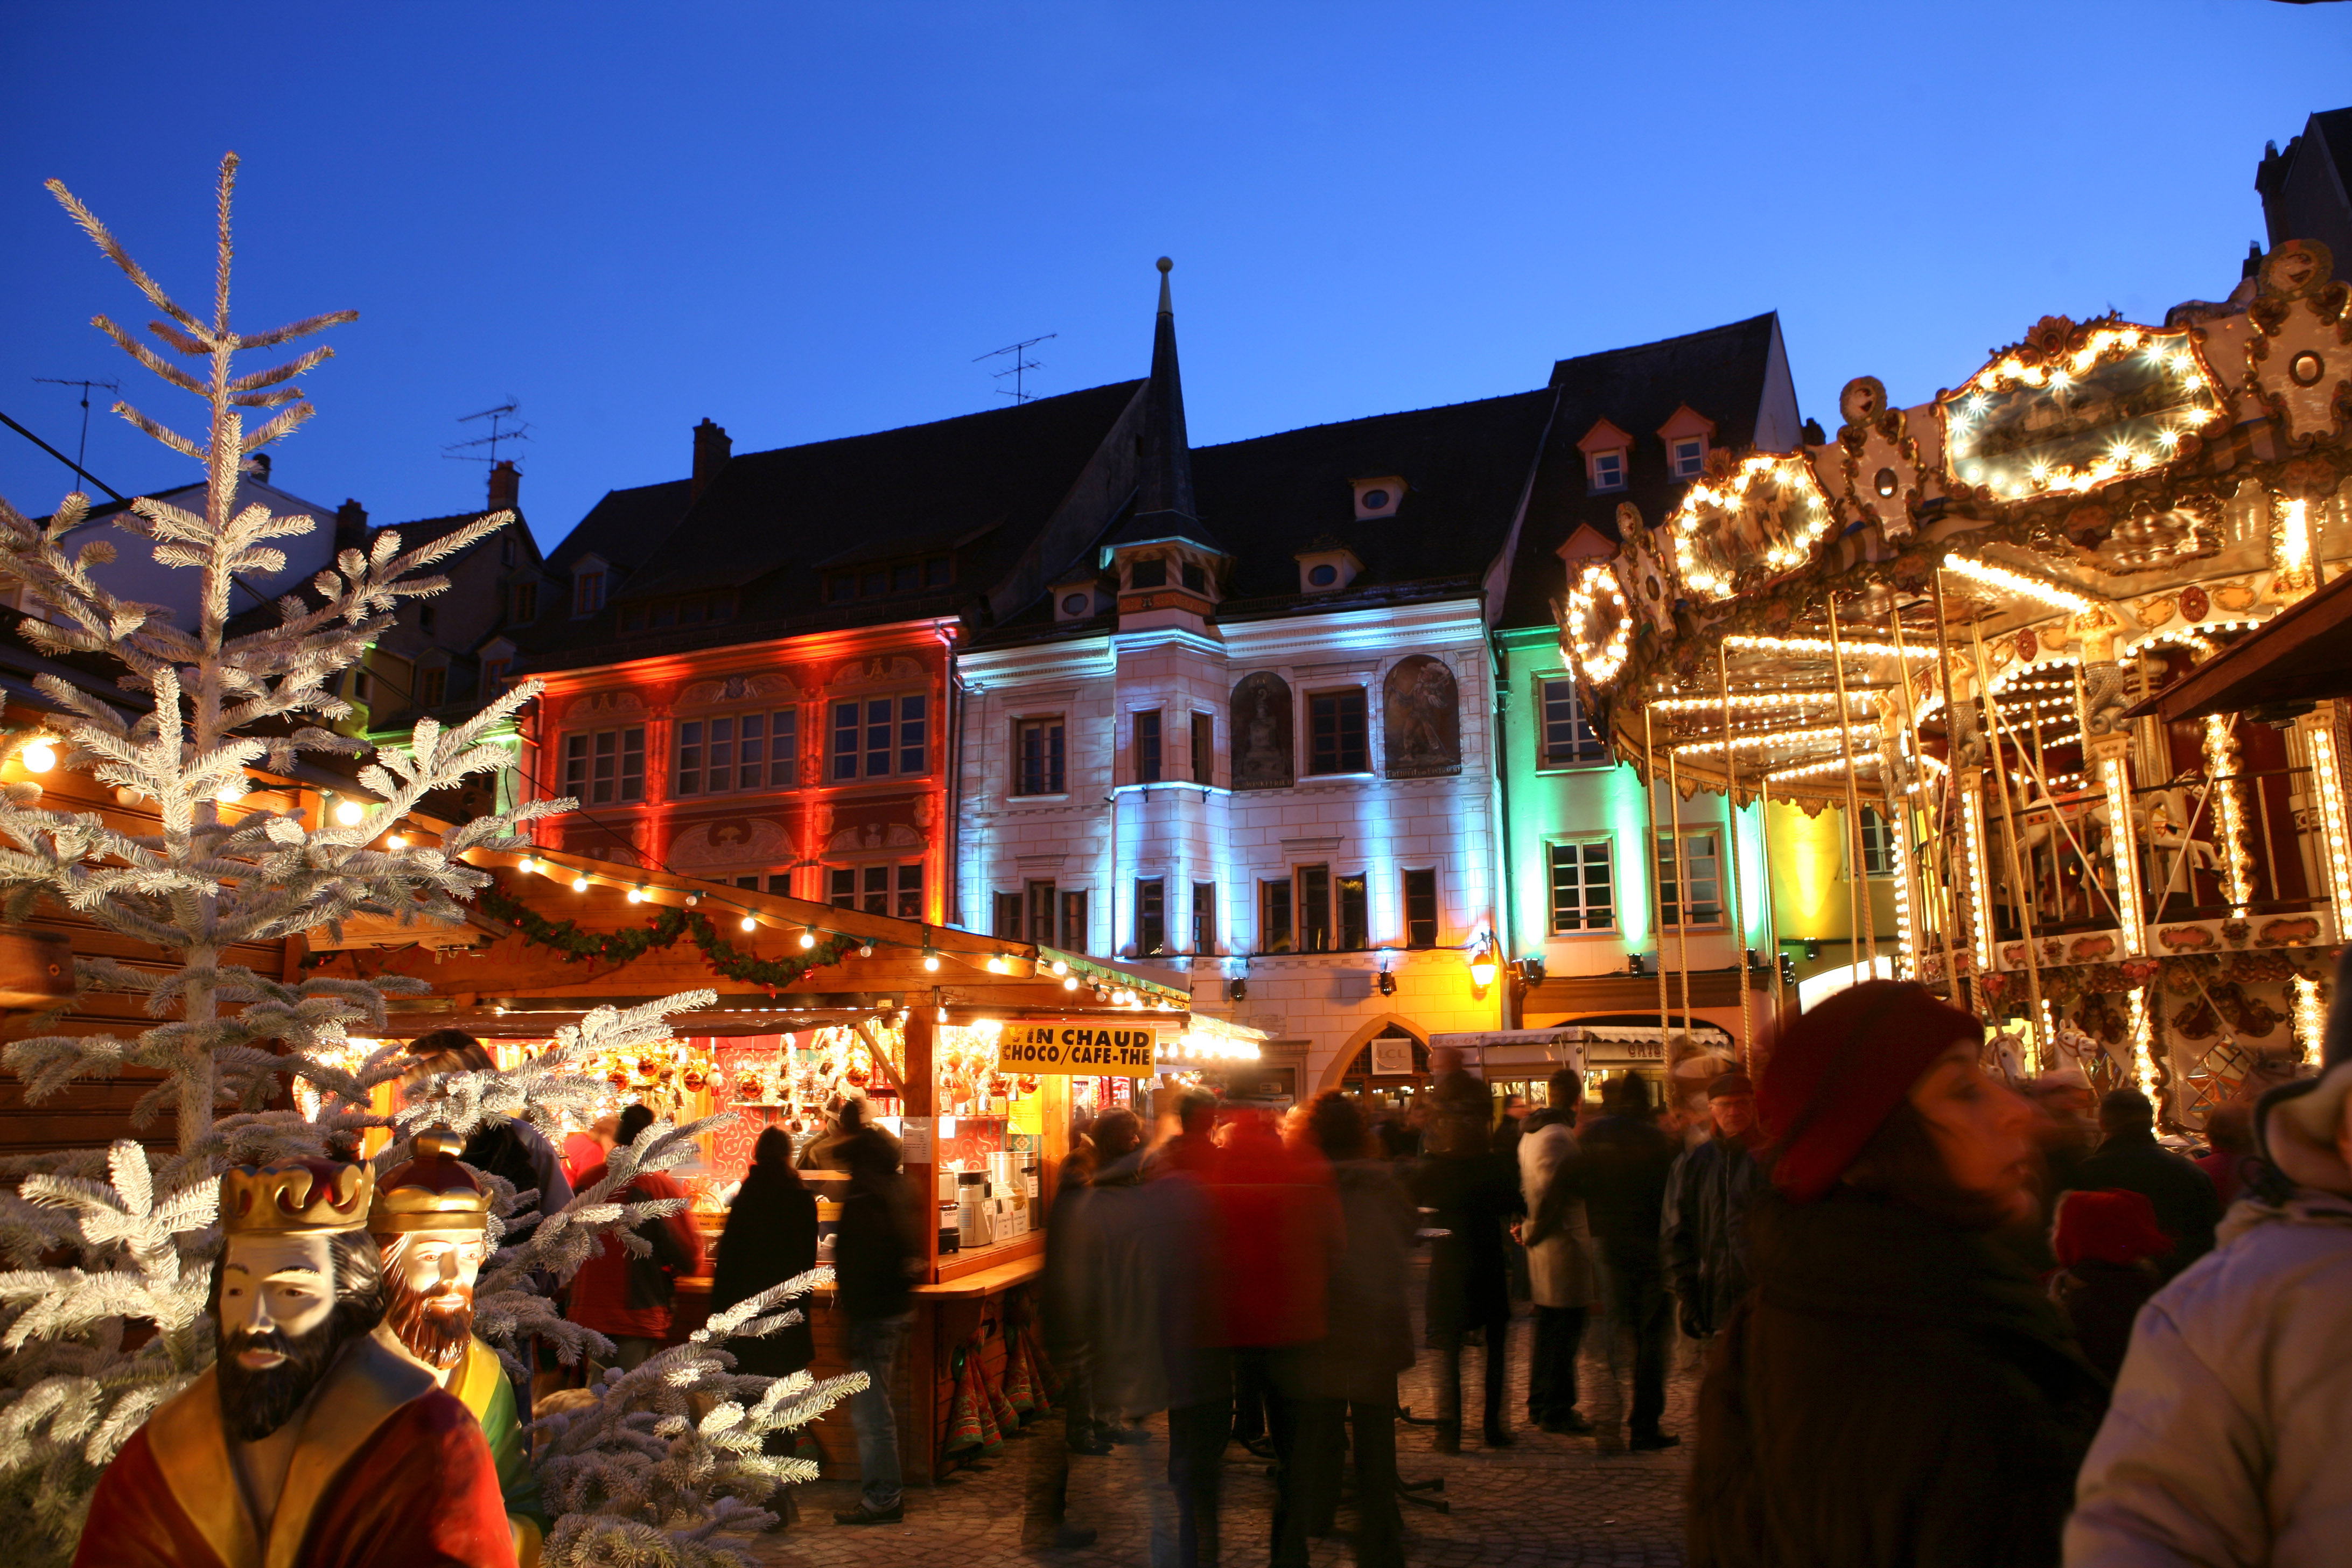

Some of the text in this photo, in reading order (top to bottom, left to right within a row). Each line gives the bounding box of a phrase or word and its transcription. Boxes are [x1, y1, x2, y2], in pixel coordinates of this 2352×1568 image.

[1009, 1025, 1150, 1047] VIN CHAUD
[1378, 1049, 1407, 1059] LCL
